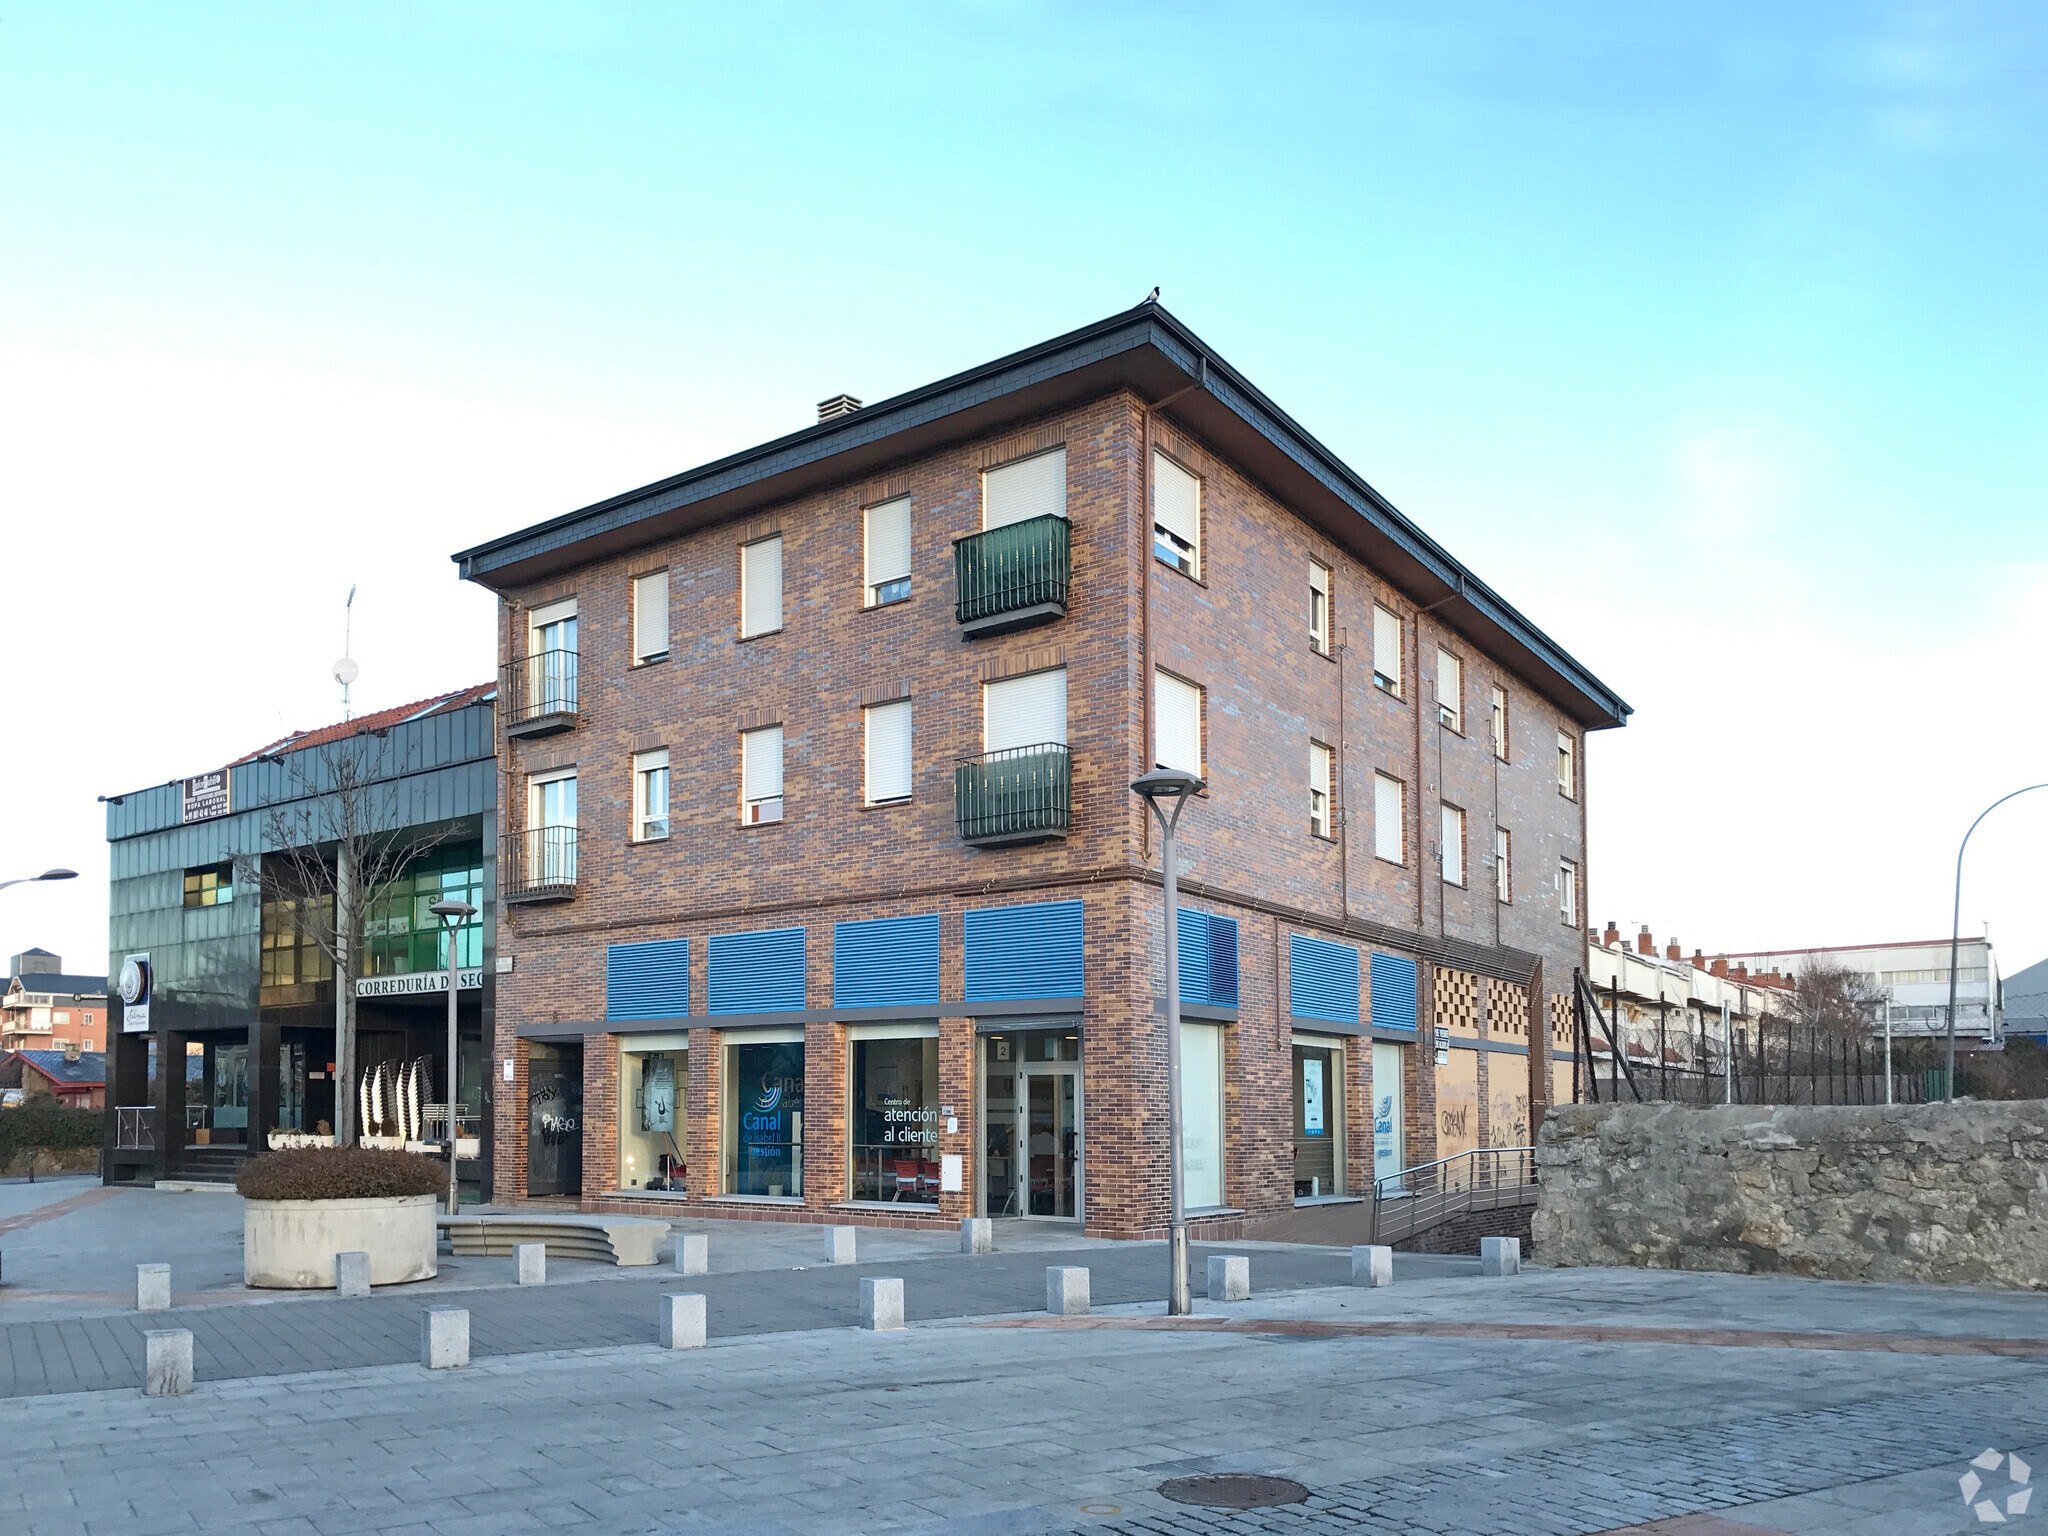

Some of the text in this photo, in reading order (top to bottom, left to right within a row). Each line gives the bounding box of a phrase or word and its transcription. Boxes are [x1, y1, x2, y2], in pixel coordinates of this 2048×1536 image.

[202, 796, 226, 807] LABORAL
[357, 974, 436, 996] CORREDURÍA
[441, 975, 449, 990] D
[1000, 1046, 1007, 1056] 2
[761, 1071, 804, 1093] Cana
[743, 1111, 781, 1131] Canal
[884, 1105, 938, 1122] atención
[1375, 1116, 1392, 1133] Canal
[743, 1132, 753, 1144] de
[754, 1132, 775, 1144] Isabel
[884, 1126, 938, 1142] al cliente
[751, 1145, 780, 1159] gestión
